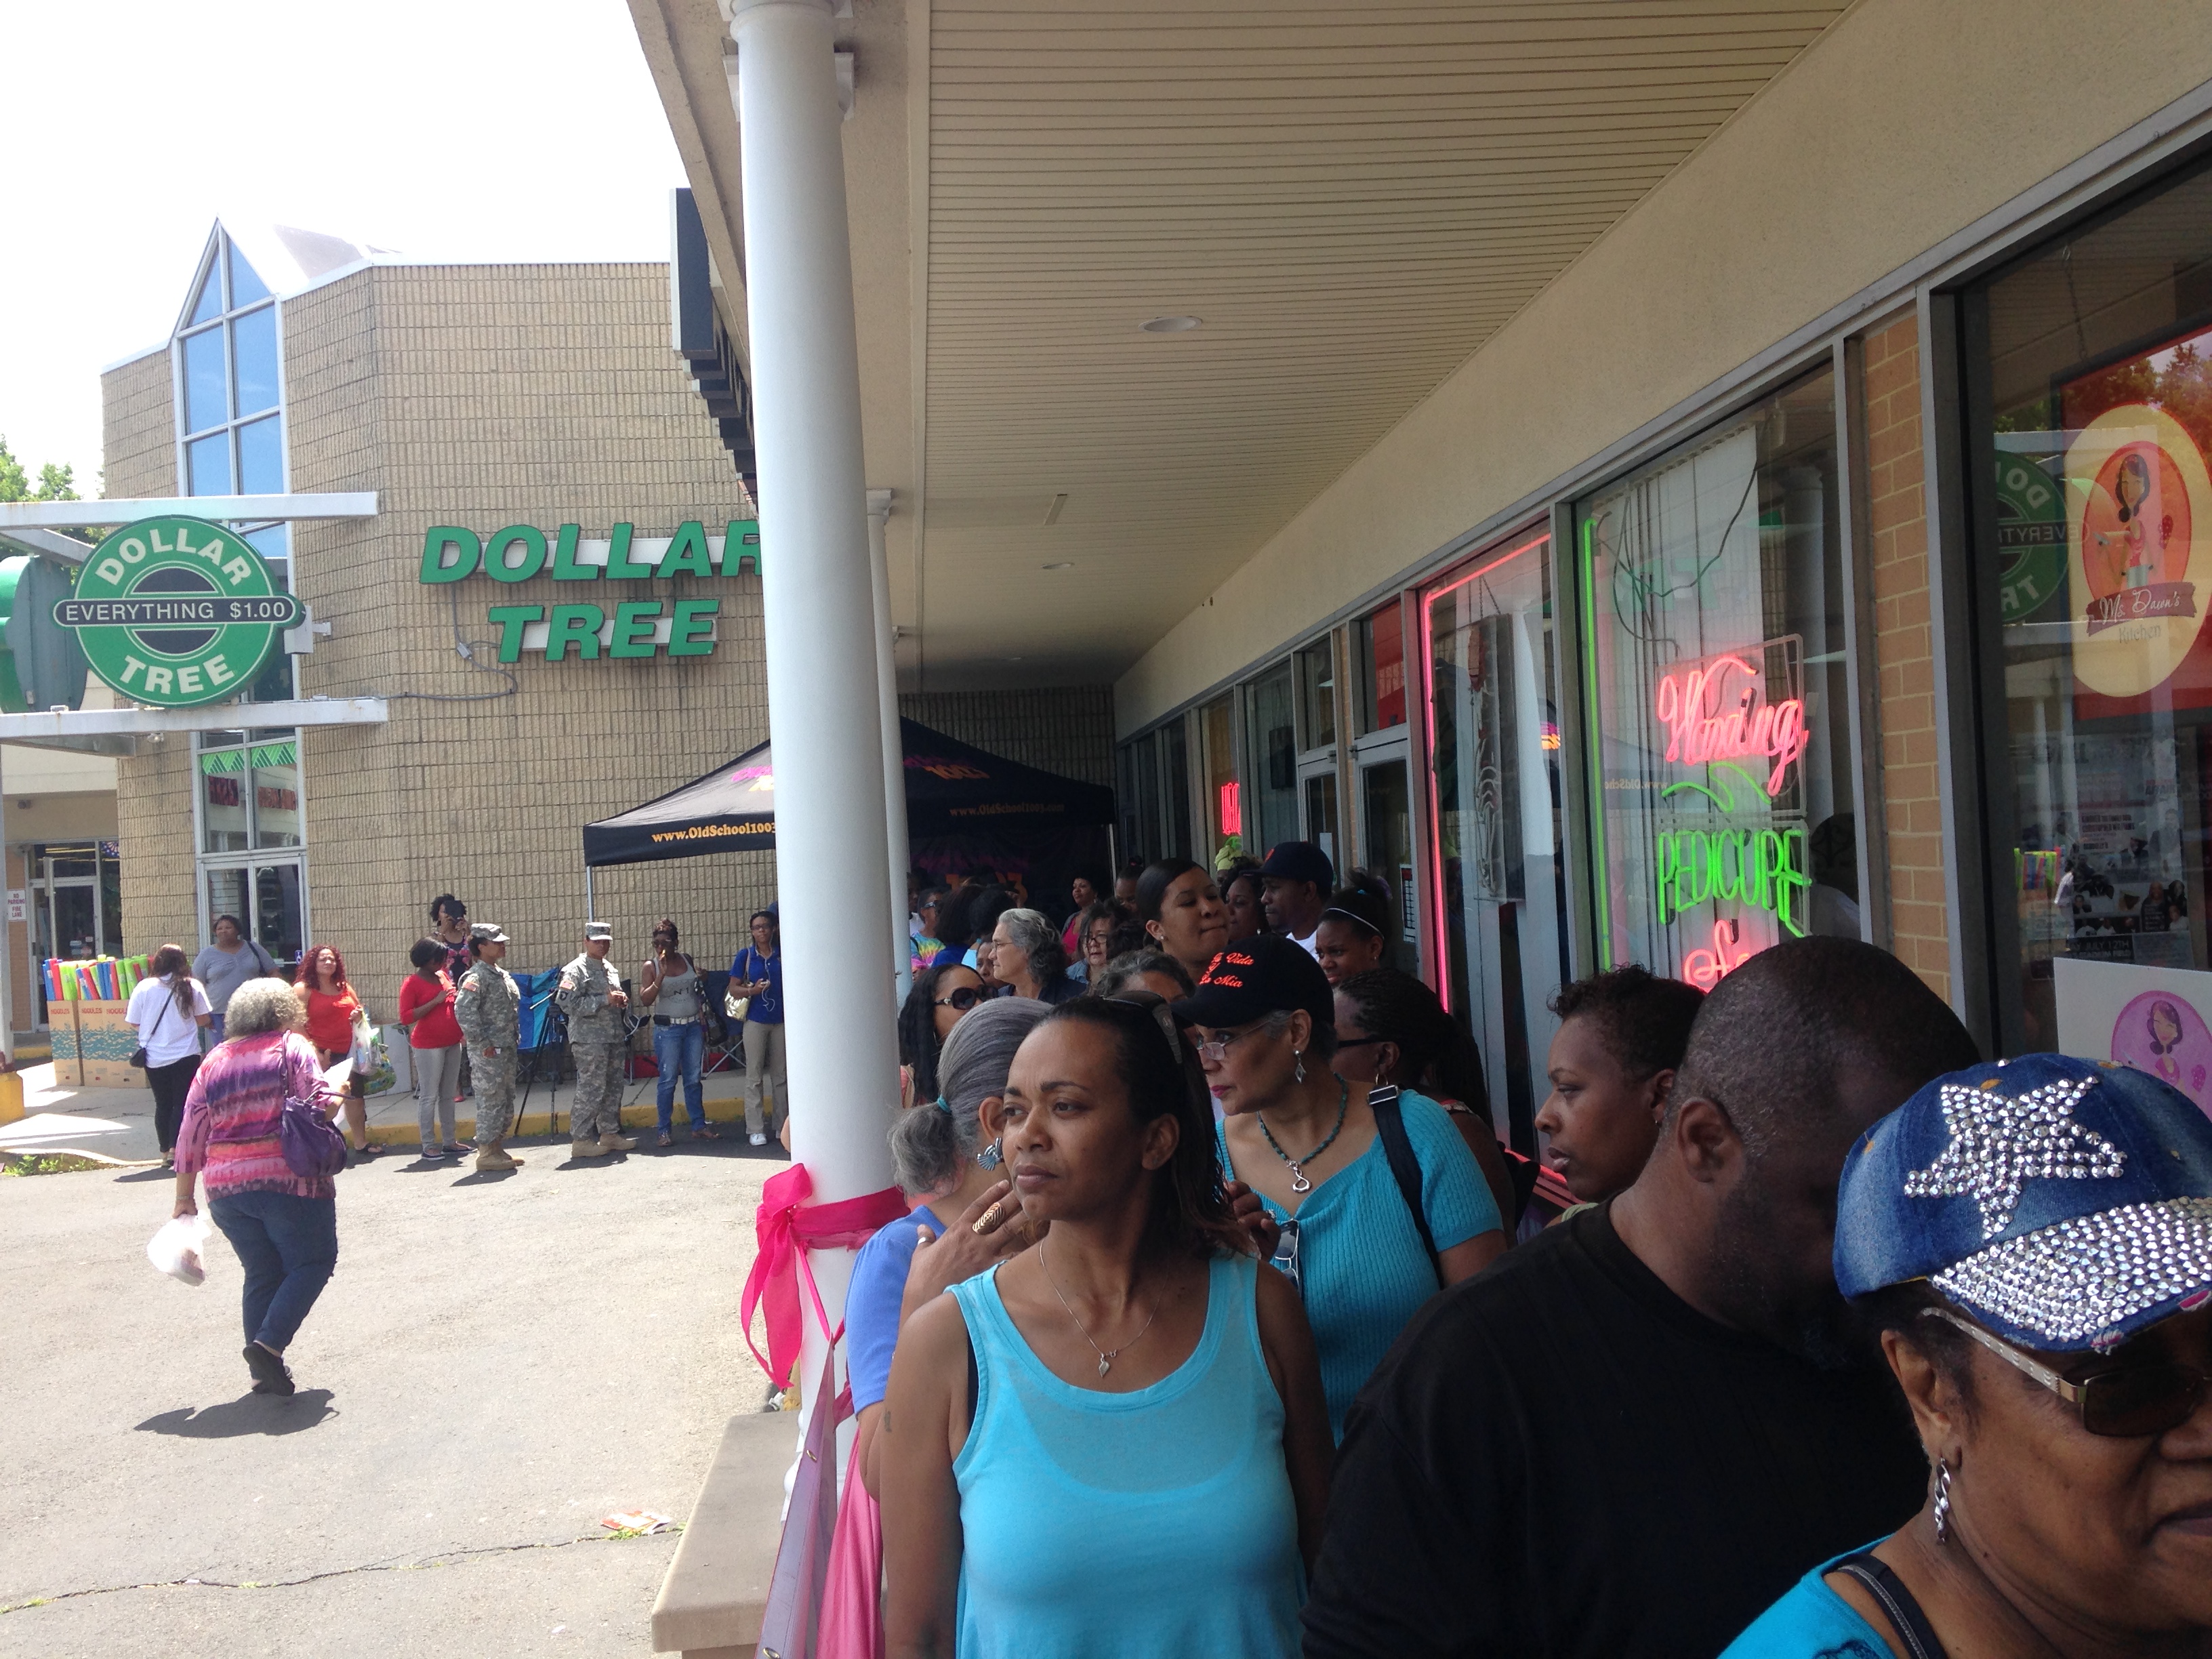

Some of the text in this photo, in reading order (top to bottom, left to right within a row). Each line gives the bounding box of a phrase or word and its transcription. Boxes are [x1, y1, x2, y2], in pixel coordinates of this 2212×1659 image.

[95, 528, 252, 586] DOLLAR
[419, 520, 762, 585] DOLLAR
[66, 601, 286, 621] EVERYTHING $1.00
[2099, 589, 2182, 626] Ms. Dawn's
[487, 599, 720, 664] TREE
[2118, 624, 2162, 644] Kitchen
[119, 653, 236, 695] TREE
[1658, 828, 1813, 938] PEDICURE
[1226, 952, 1254, 966] Vida
